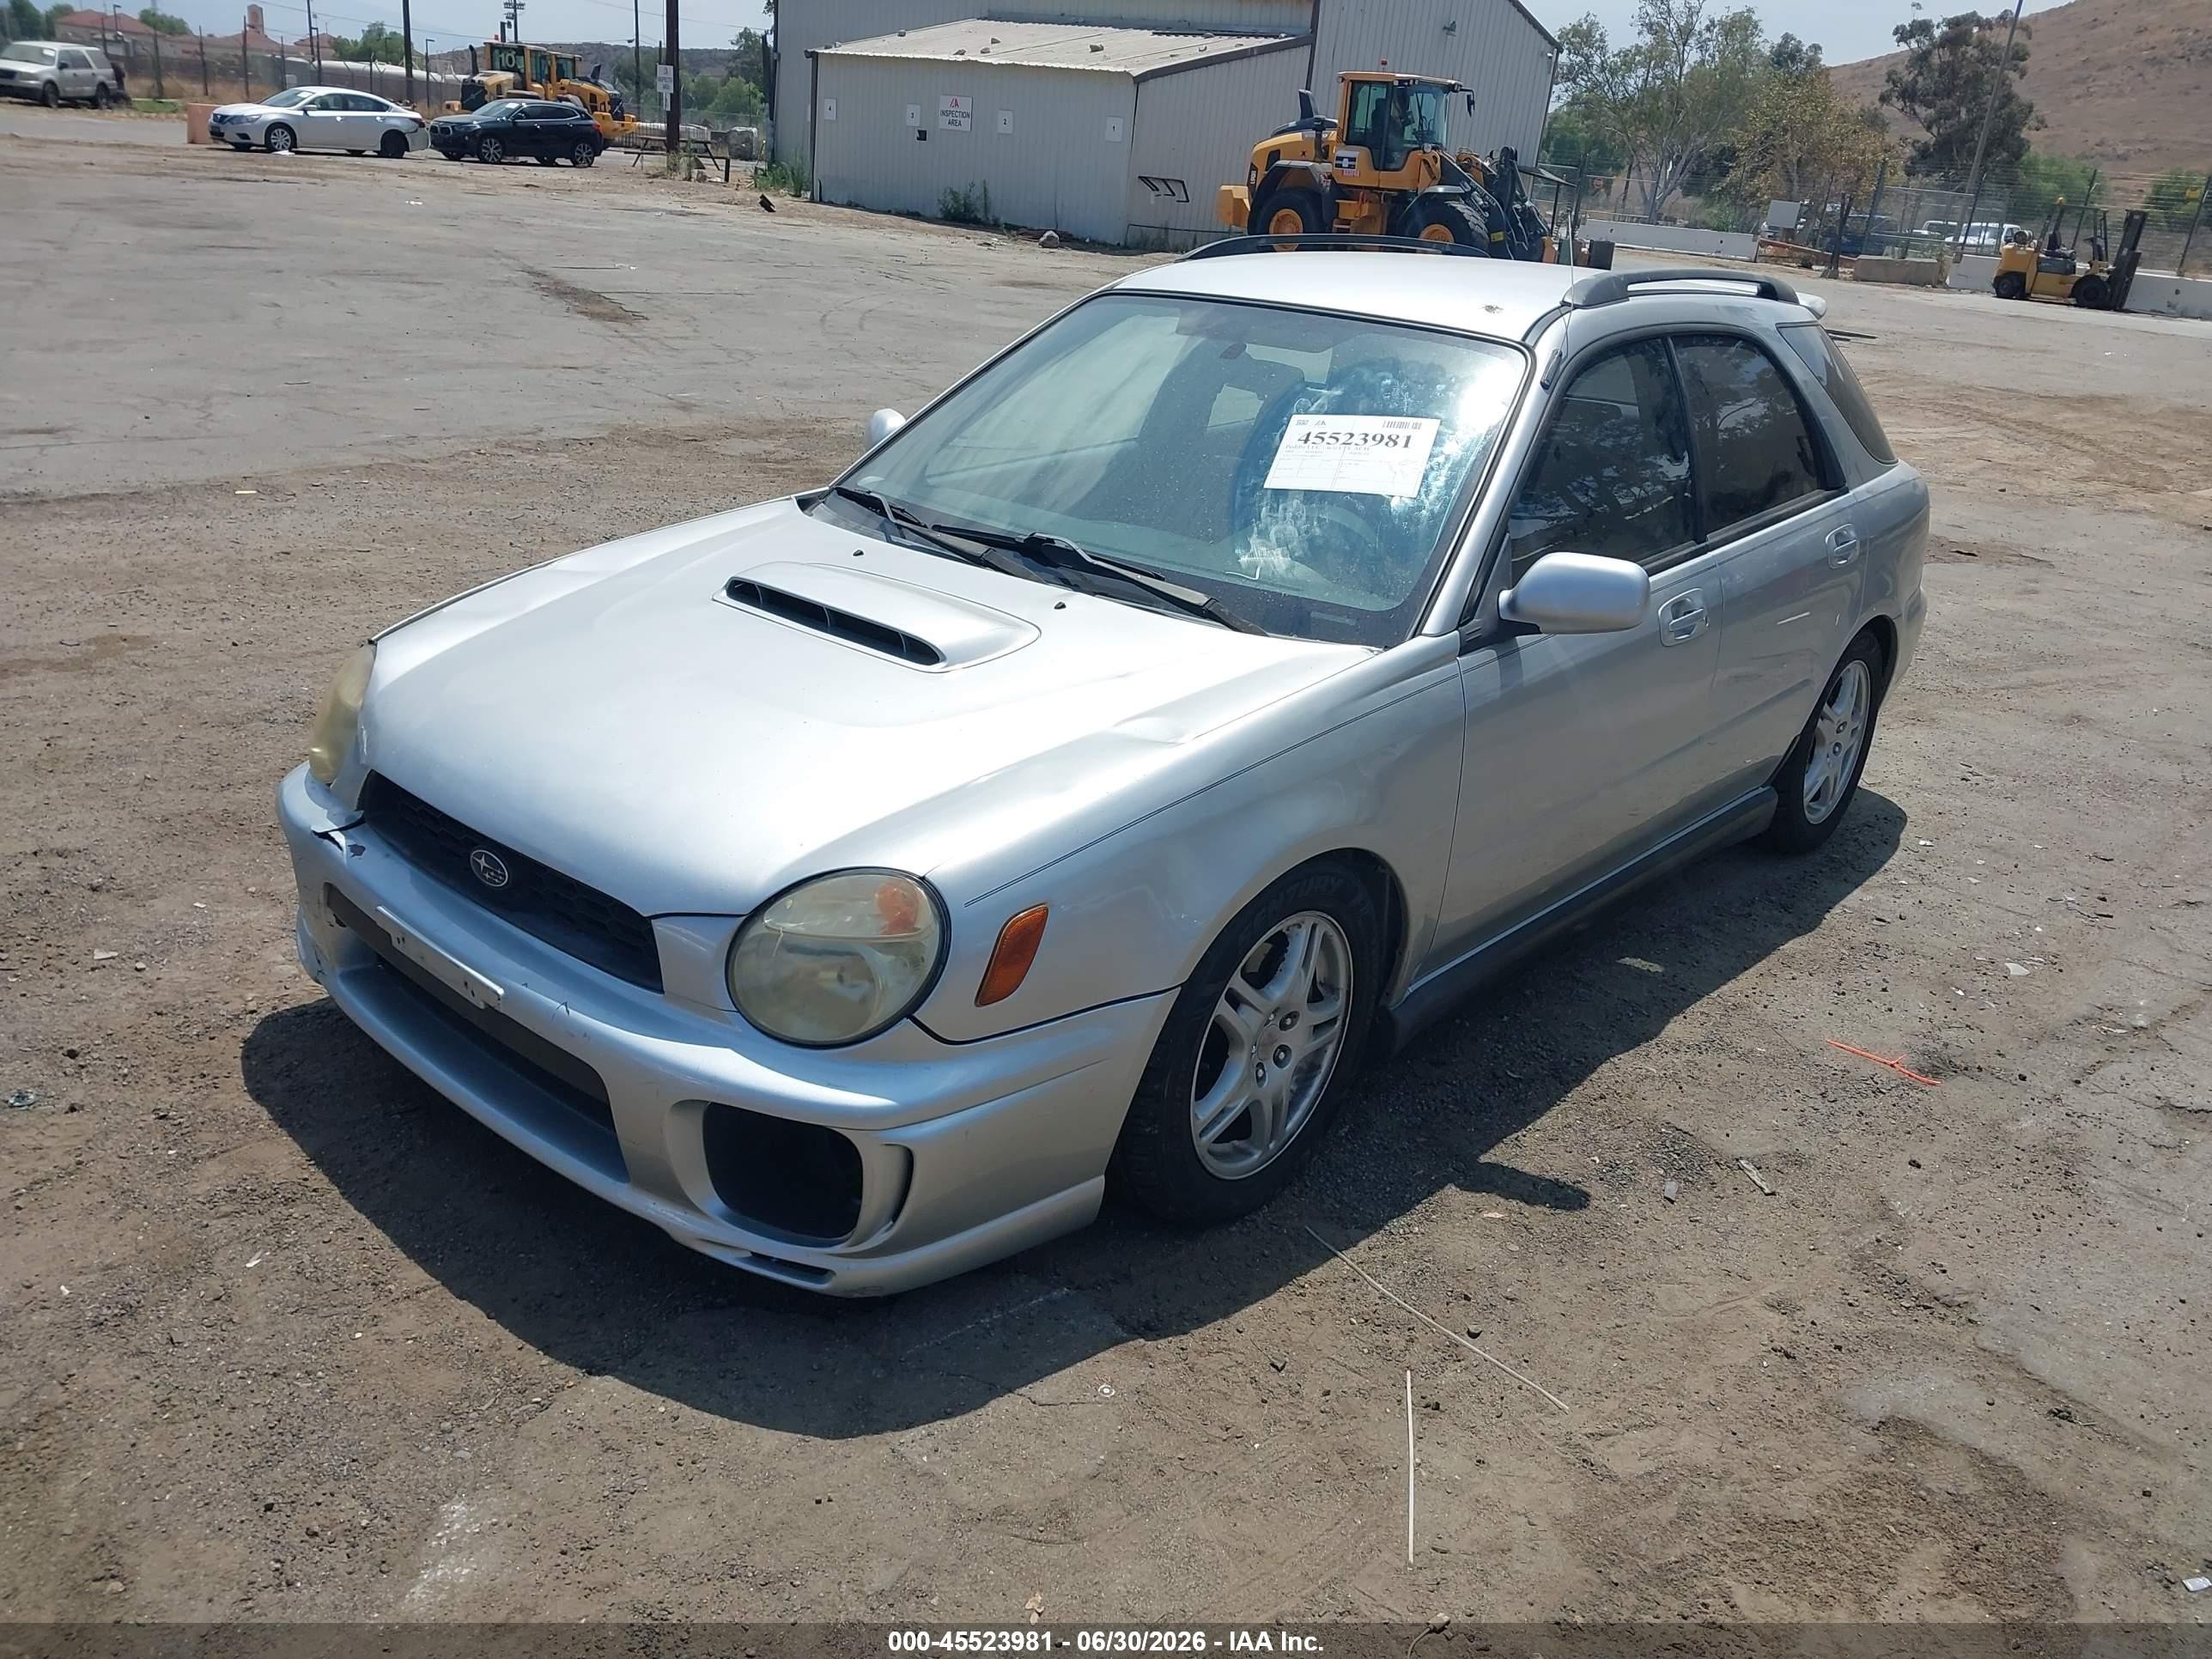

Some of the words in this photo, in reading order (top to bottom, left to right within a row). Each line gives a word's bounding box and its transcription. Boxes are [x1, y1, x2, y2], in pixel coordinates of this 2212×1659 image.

[939, 109, 970, 119] INSPECTION
[947, 118, 963, 127] AREA
[1297, 431, 1412, 449] 45523981
